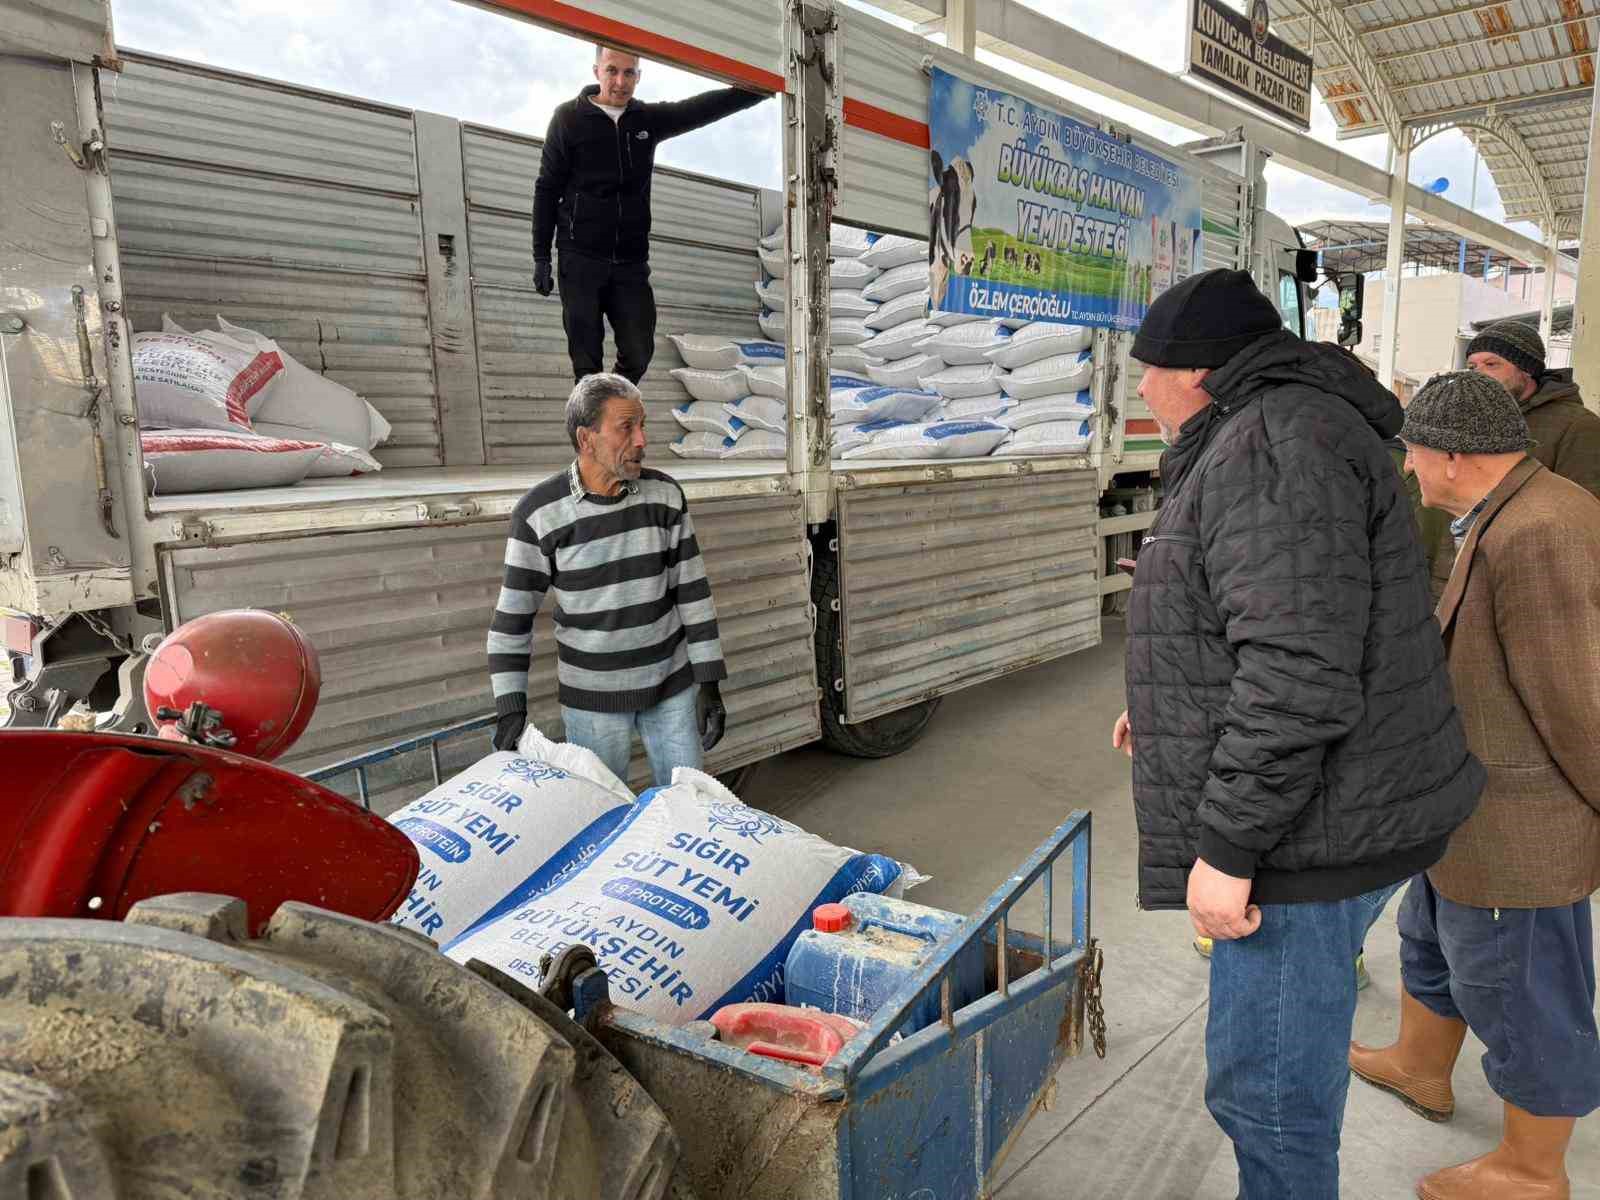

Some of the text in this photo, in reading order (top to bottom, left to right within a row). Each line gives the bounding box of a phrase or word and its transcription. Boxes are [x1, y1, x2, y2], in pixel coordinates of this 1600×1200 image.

[1198, 2, 1252, 58] KUYUCAK
[1200, 40, 1305, 114] YAMALAK PAZAR YERİ
[996, 102, 1020, 127] T.C.
[1022, 111, 1060, 142] AYDIN
[1066, 126, 1133, 170] BÜYÜKŞEHİR
[997, 138, 1145, 219] BÜYÜKBAŞ HAYVAN
[1016, 199, 1130, 259] YEM DESTEĞİ
[968, 281, 1072, 319] ÖZLEM ÇERÇİOĞLU
[409, 797, 521, 856] SÜT YEMİ
[458, 781, 523, 814] SIĞIR
[666, 832, 750, 876] SIĞIR
[614, 850, 761, 922] SÜT YEMİ
[628, 887, 703, 926] PROTEİN
[513, 907, 695, 1007] BÜYÜKŞEHİR
[567, 900, 686, 960] T.C. AYDIN
